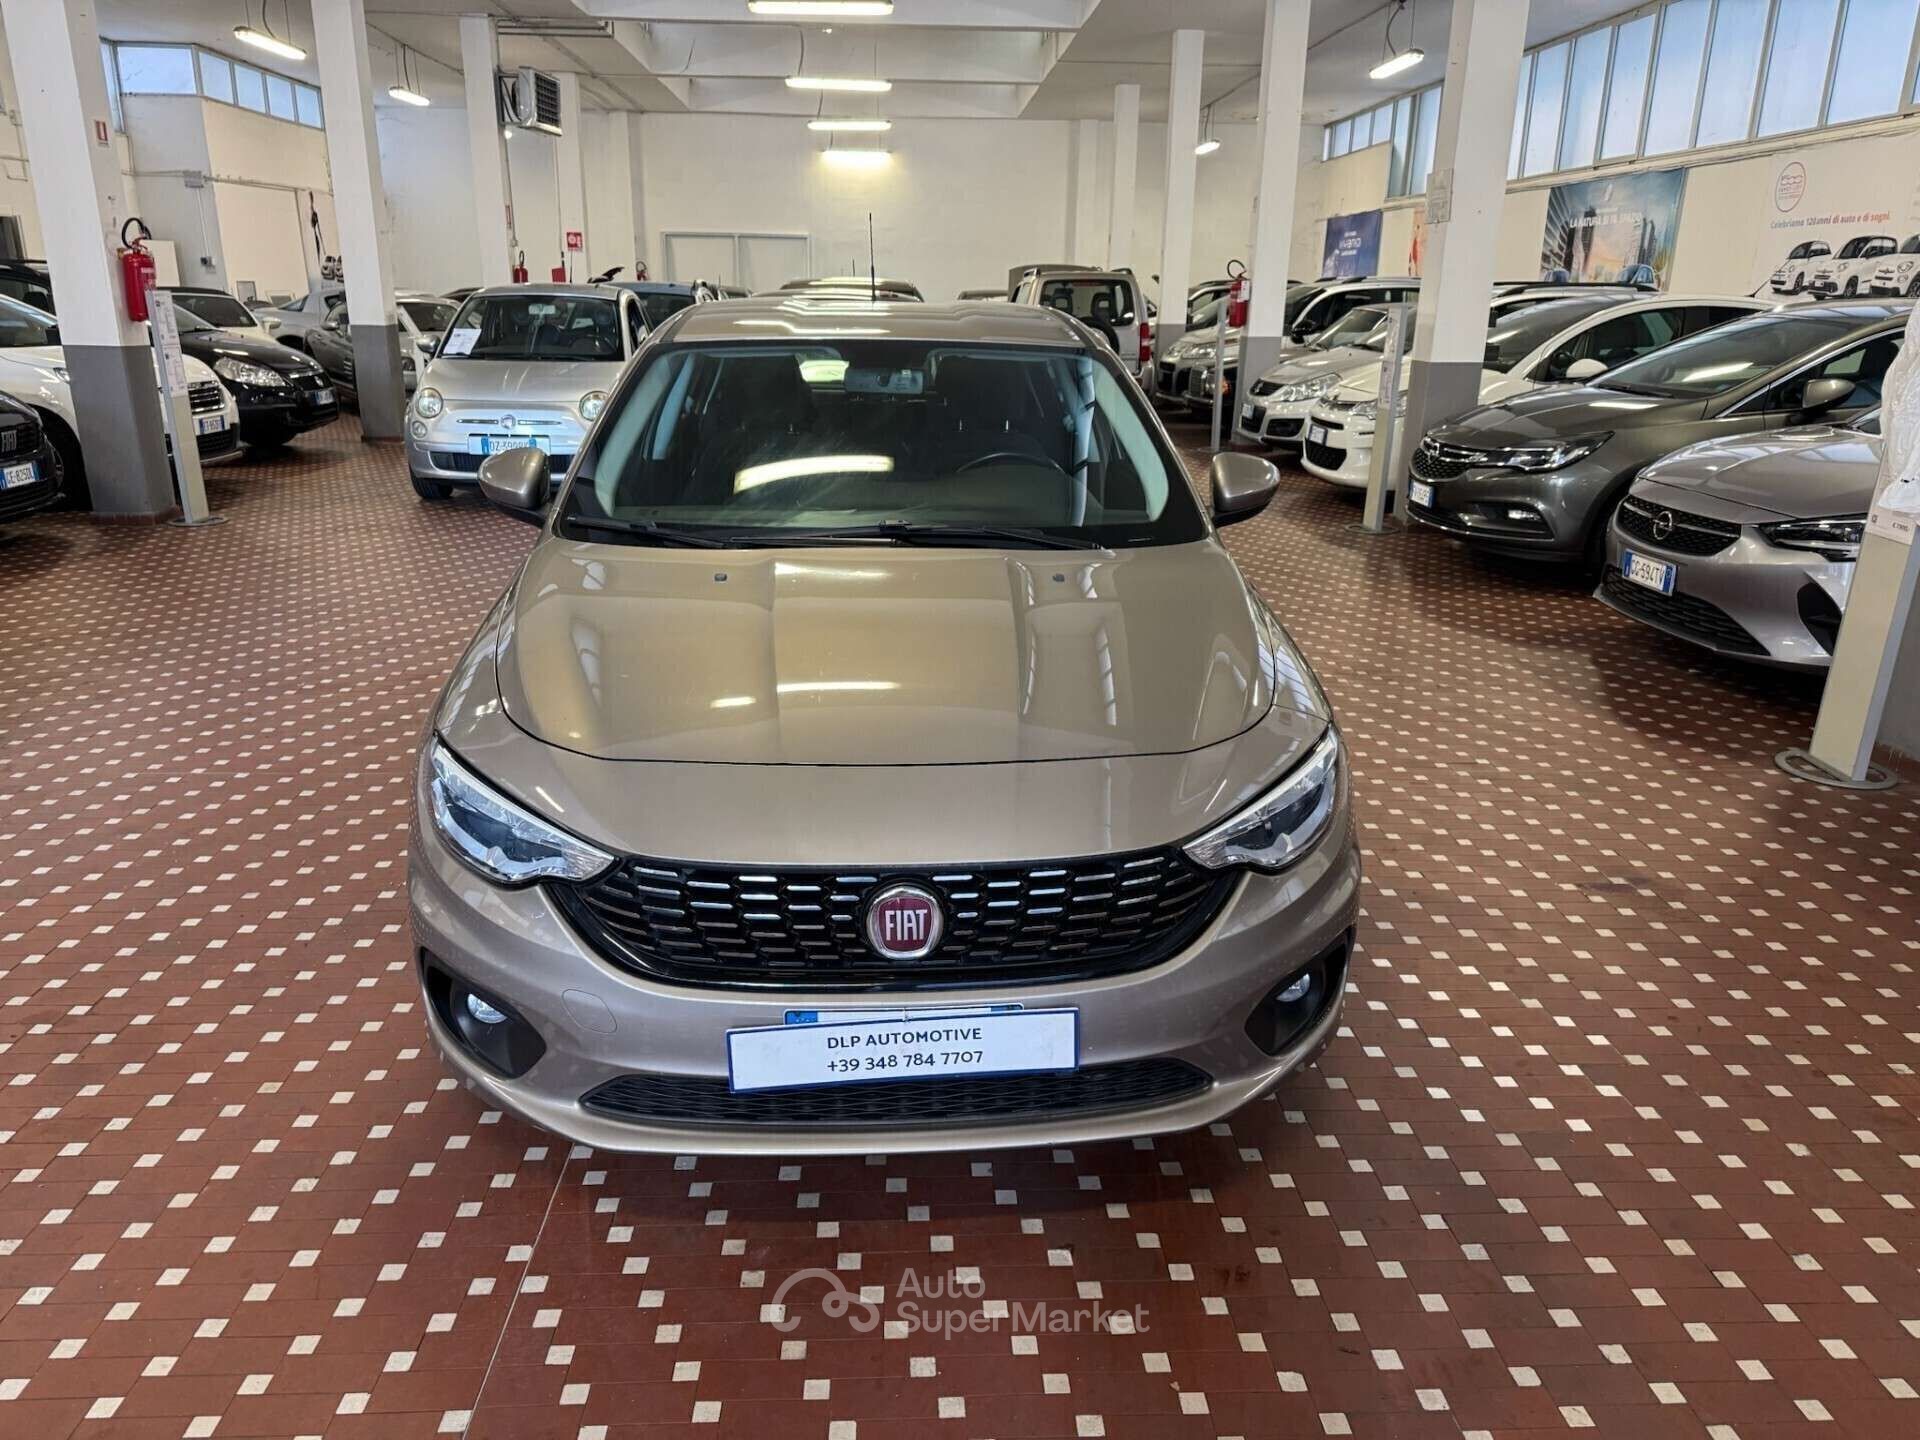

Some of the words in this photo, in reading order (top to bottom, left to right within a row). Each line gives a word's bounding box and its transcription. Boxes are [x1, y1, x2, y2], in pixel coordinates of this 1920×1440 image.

[884, 908, 928, 941] FIAT
[827, 1035, 861, 1049] DLP
[865, 1028, 982, 1046] AUTOMOTIVE
[827, 1058, 860, 1072] +39
[865, 1054, 898, 1071] 348
[903, 1053, 936, 1067] 784
[940, 1050, 983, 1065] 7707
